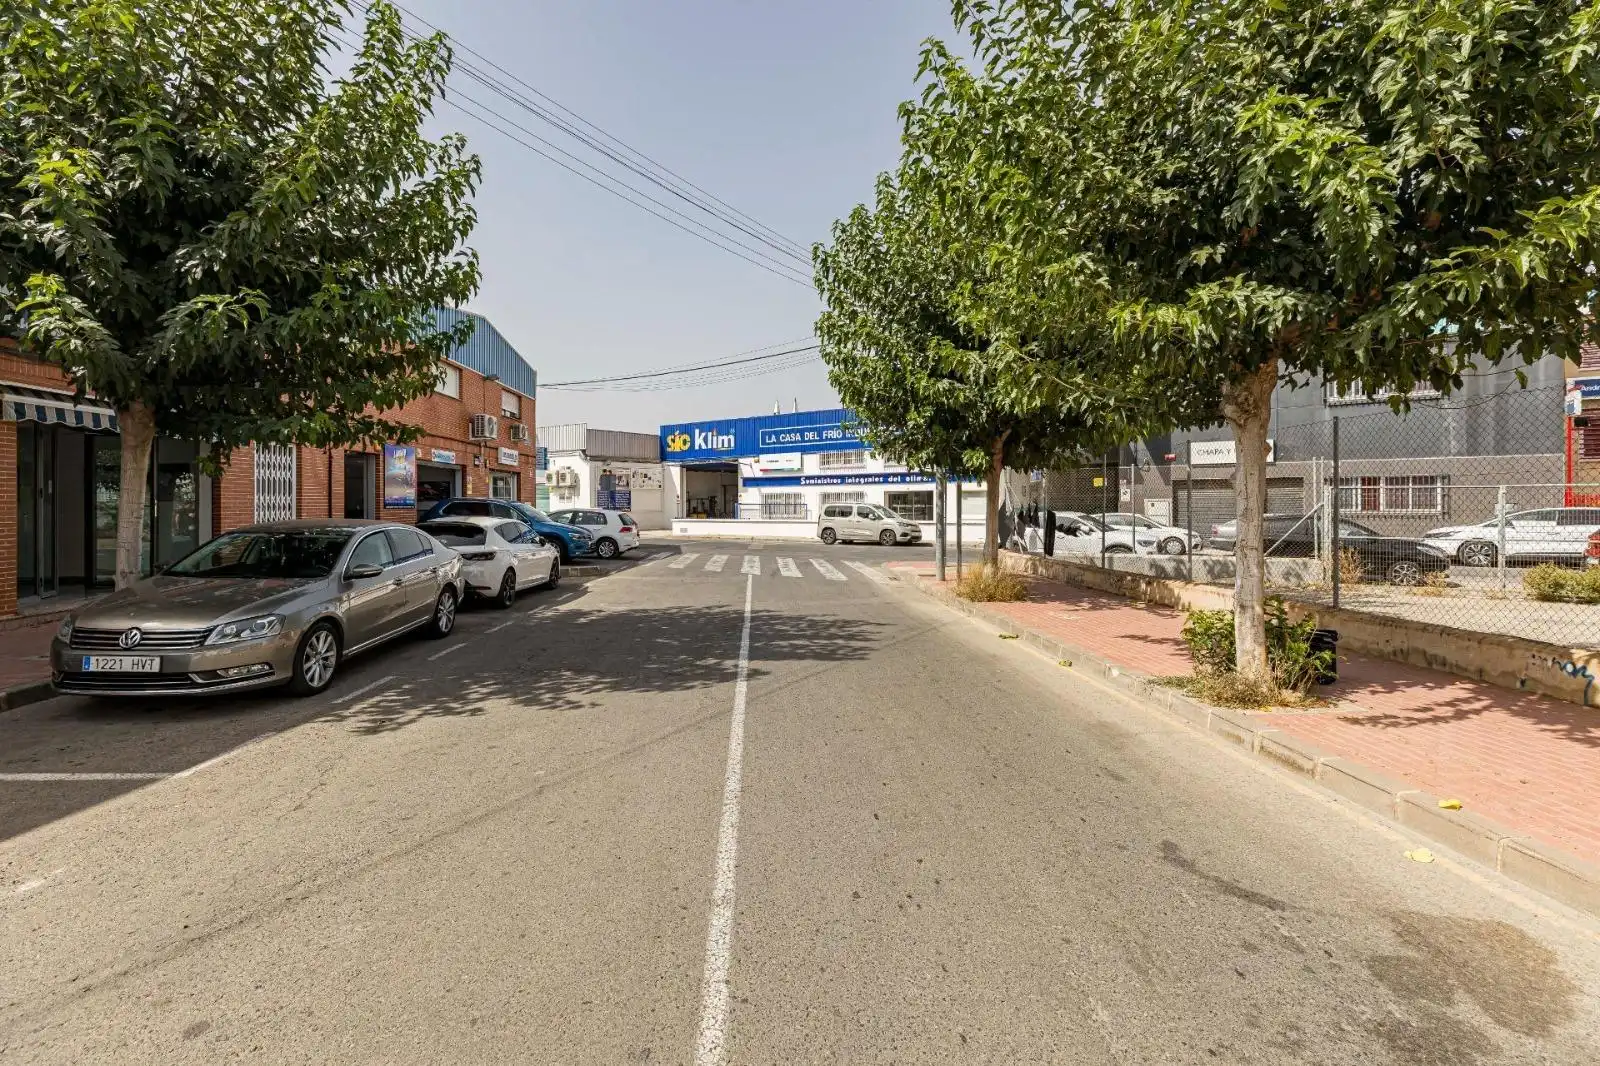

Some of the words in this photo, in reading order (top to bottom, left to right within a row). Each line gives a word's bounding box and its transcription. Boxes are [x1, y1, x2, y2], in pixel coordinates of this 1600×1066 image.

[766, 434, 776, 443] LA
[779, 432, 801, 442] CASA
[804, 431, 819, 440] DEL
[822, 428, 842, 439] FRÍO
[1196, 447, 1225, 456] CHAPA
[800, 476, 841, 485] Suministros
[845, 475, 883, 484] integrales
[95, 657, 123, 670] 1221
[131, 657, 156, 671] HVT
